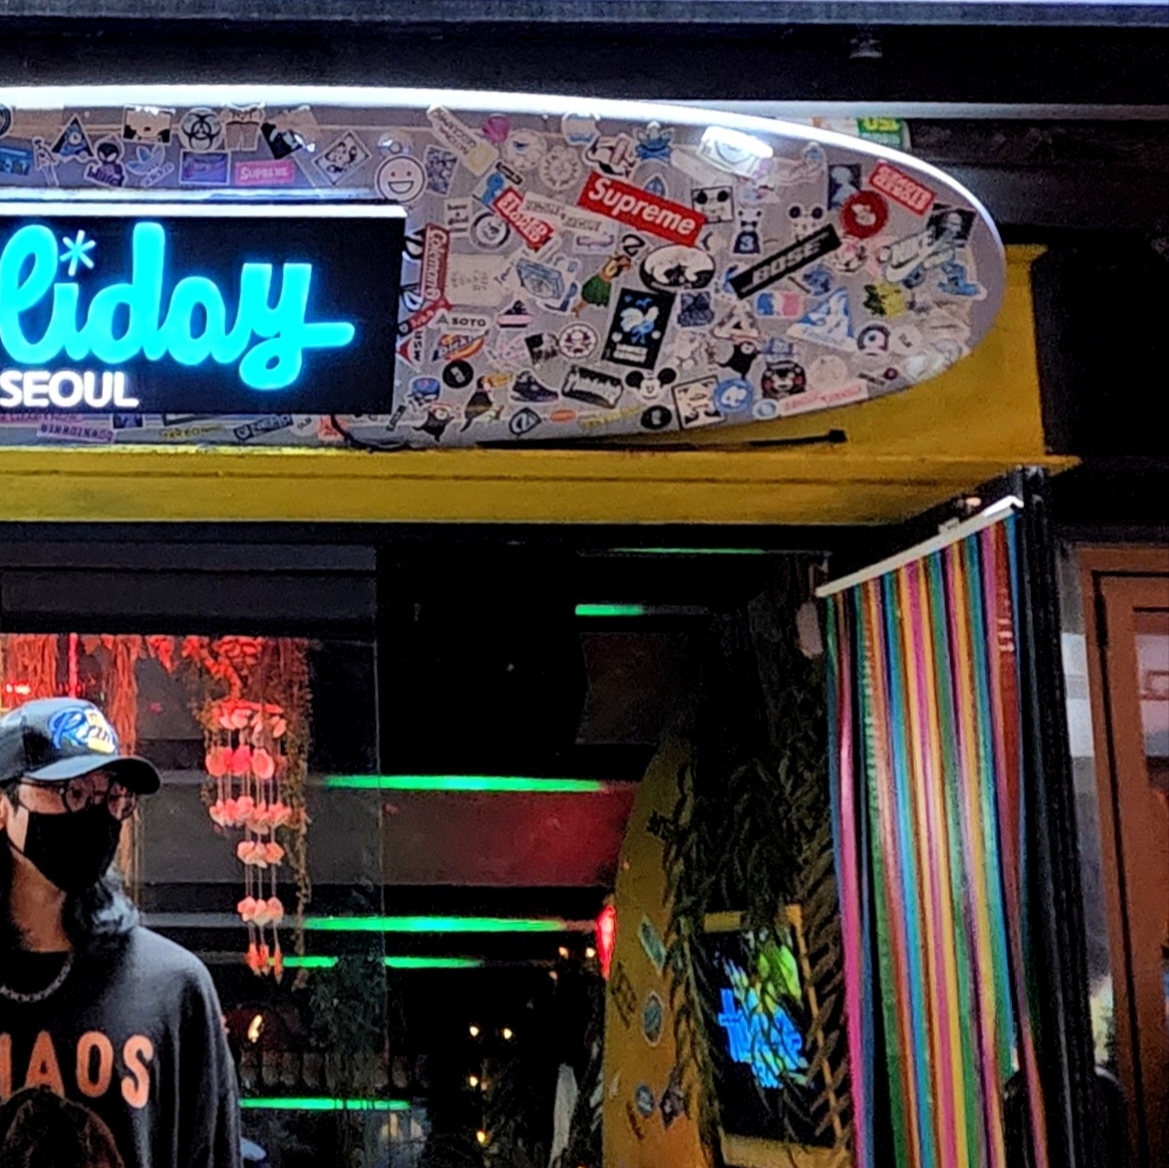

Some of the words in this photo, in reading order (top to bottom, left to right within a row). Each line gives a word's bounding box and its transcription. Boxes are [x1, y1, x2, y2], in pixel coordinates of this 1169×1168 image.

[587, 177, 697, 236] Supreme
[429, 228, 444, 291] Coleman
[752, 242, 823, 282] BOSE
[451, 316, 487, 328] SOTO
